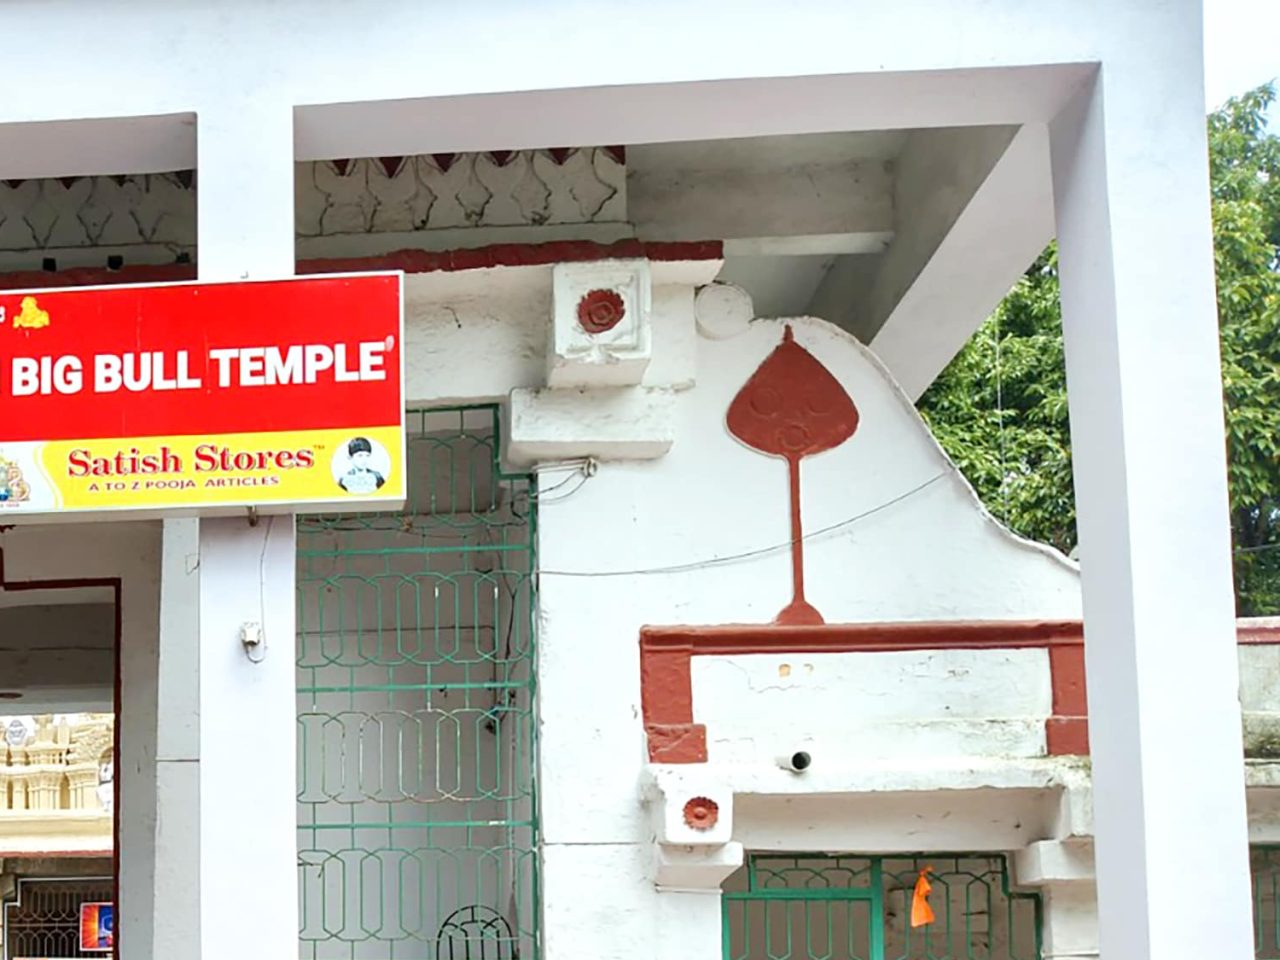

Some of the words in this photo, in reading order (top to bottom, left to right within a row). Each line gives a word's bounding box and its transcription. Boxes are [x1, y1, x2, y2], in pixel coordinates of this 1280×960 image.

[11, 356, 83, 396] BIG
[93, 350, 202, 393] BULL
[209, 341, 387, 387] TEMPLE
[68, 446, 183, 477] Satish
[194, 443, 315, 472] Stores
[88, 483, 100, 492] A
[105, 482, 127, 491] TO
[131, 481, 140, 490] Z
[145, 479, 196, 490] POOJA
[204, 476, 280, 488] ARTICLES
